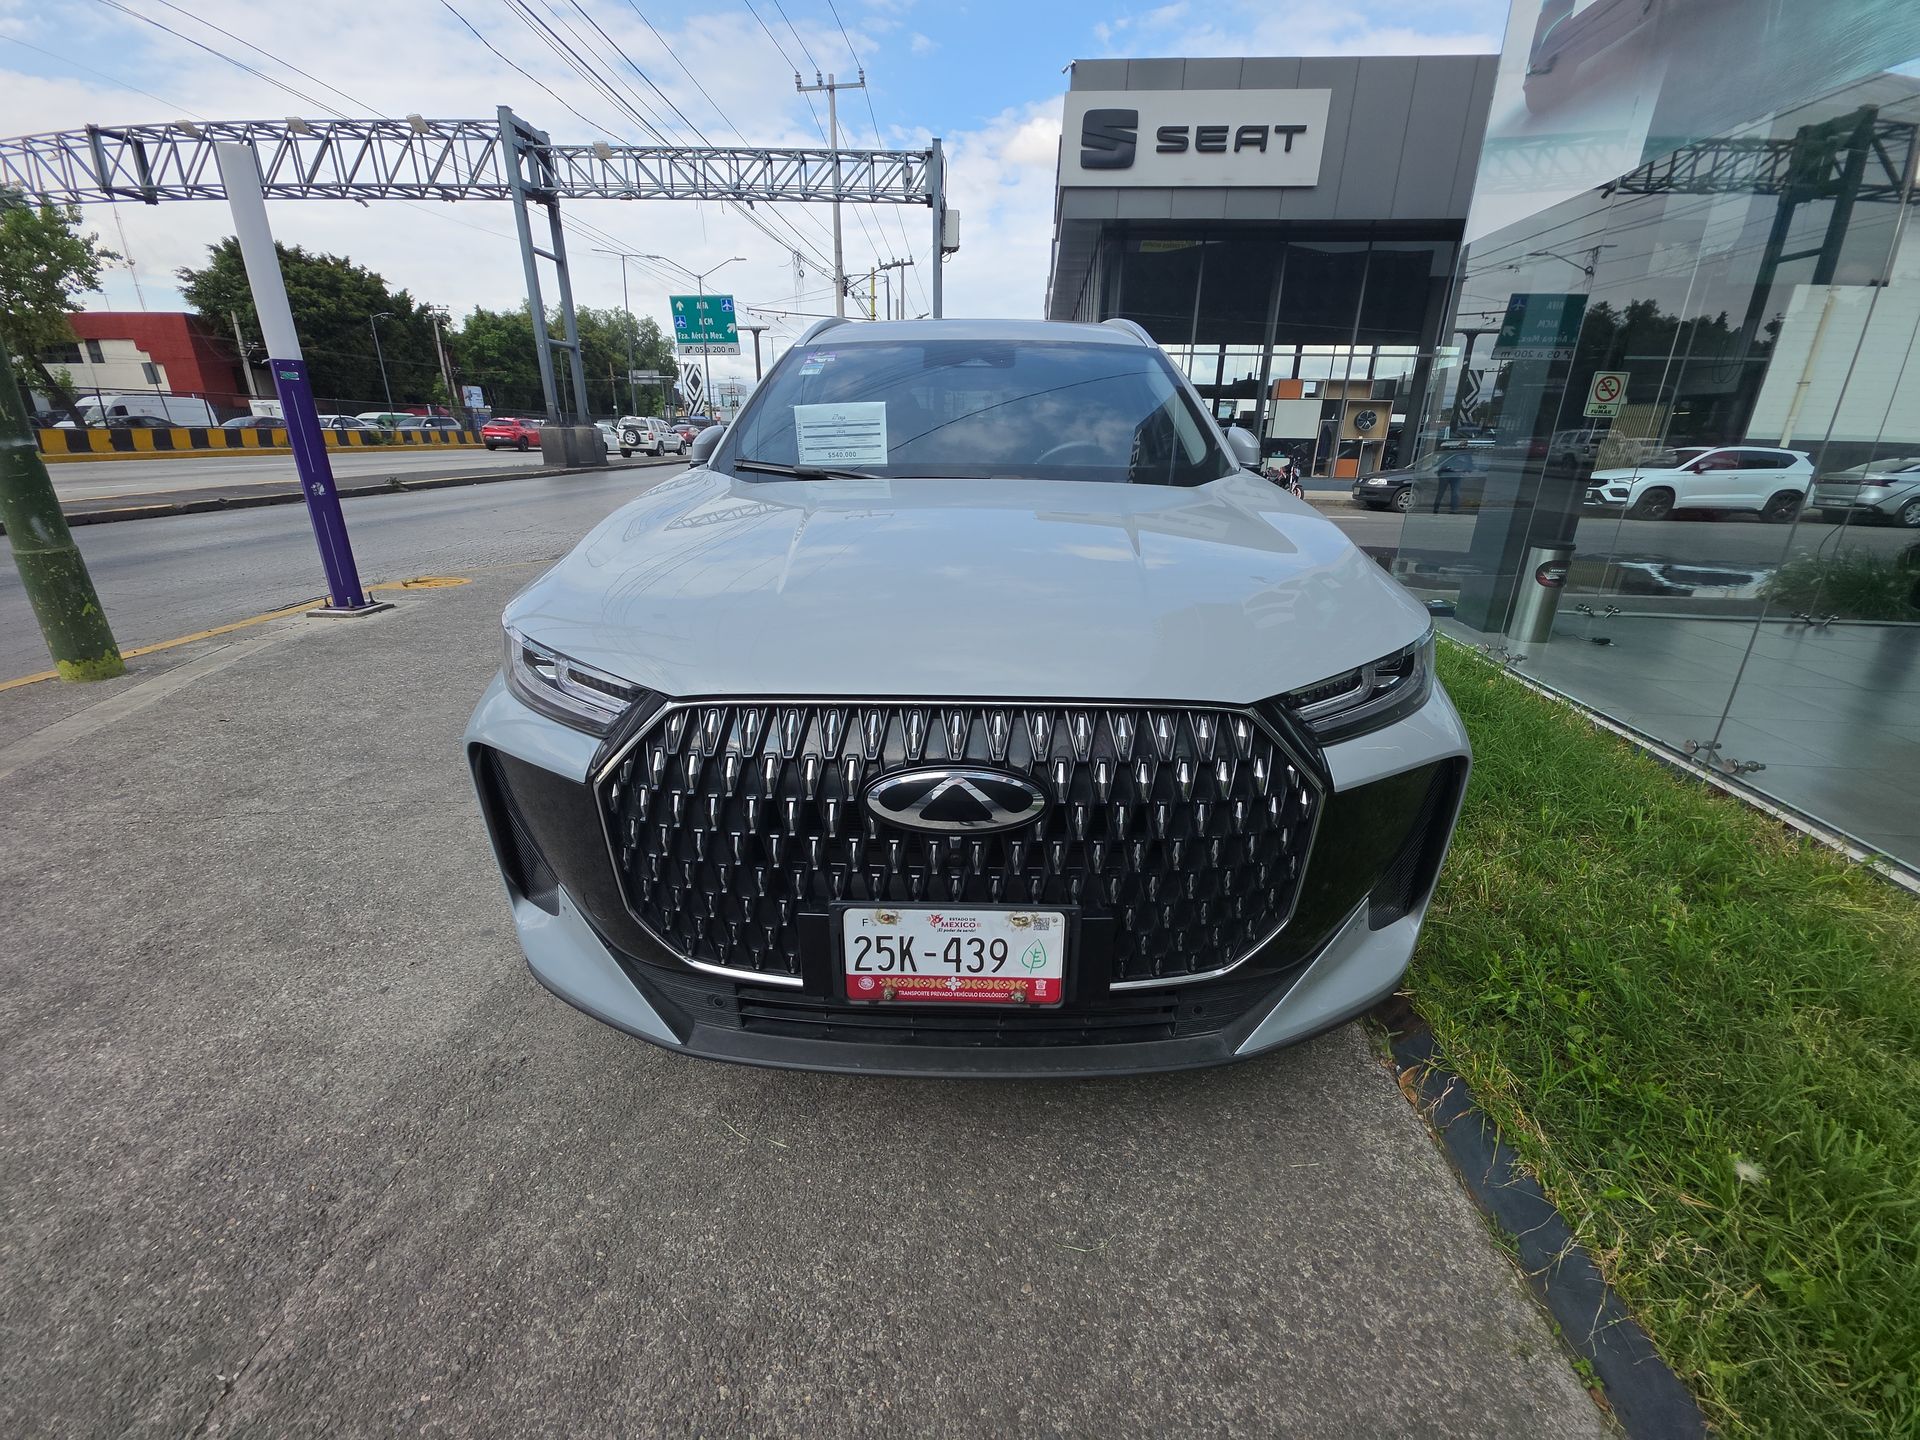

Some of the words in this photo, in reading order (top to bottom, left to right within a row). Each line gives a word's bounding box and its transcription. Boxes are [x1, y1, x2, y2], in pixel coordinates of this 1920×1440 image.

[1156, 125, 1307, 153] SEAT
[862, 918, 869, 927] F
[854, 935, 1009, 973] 25K-439
